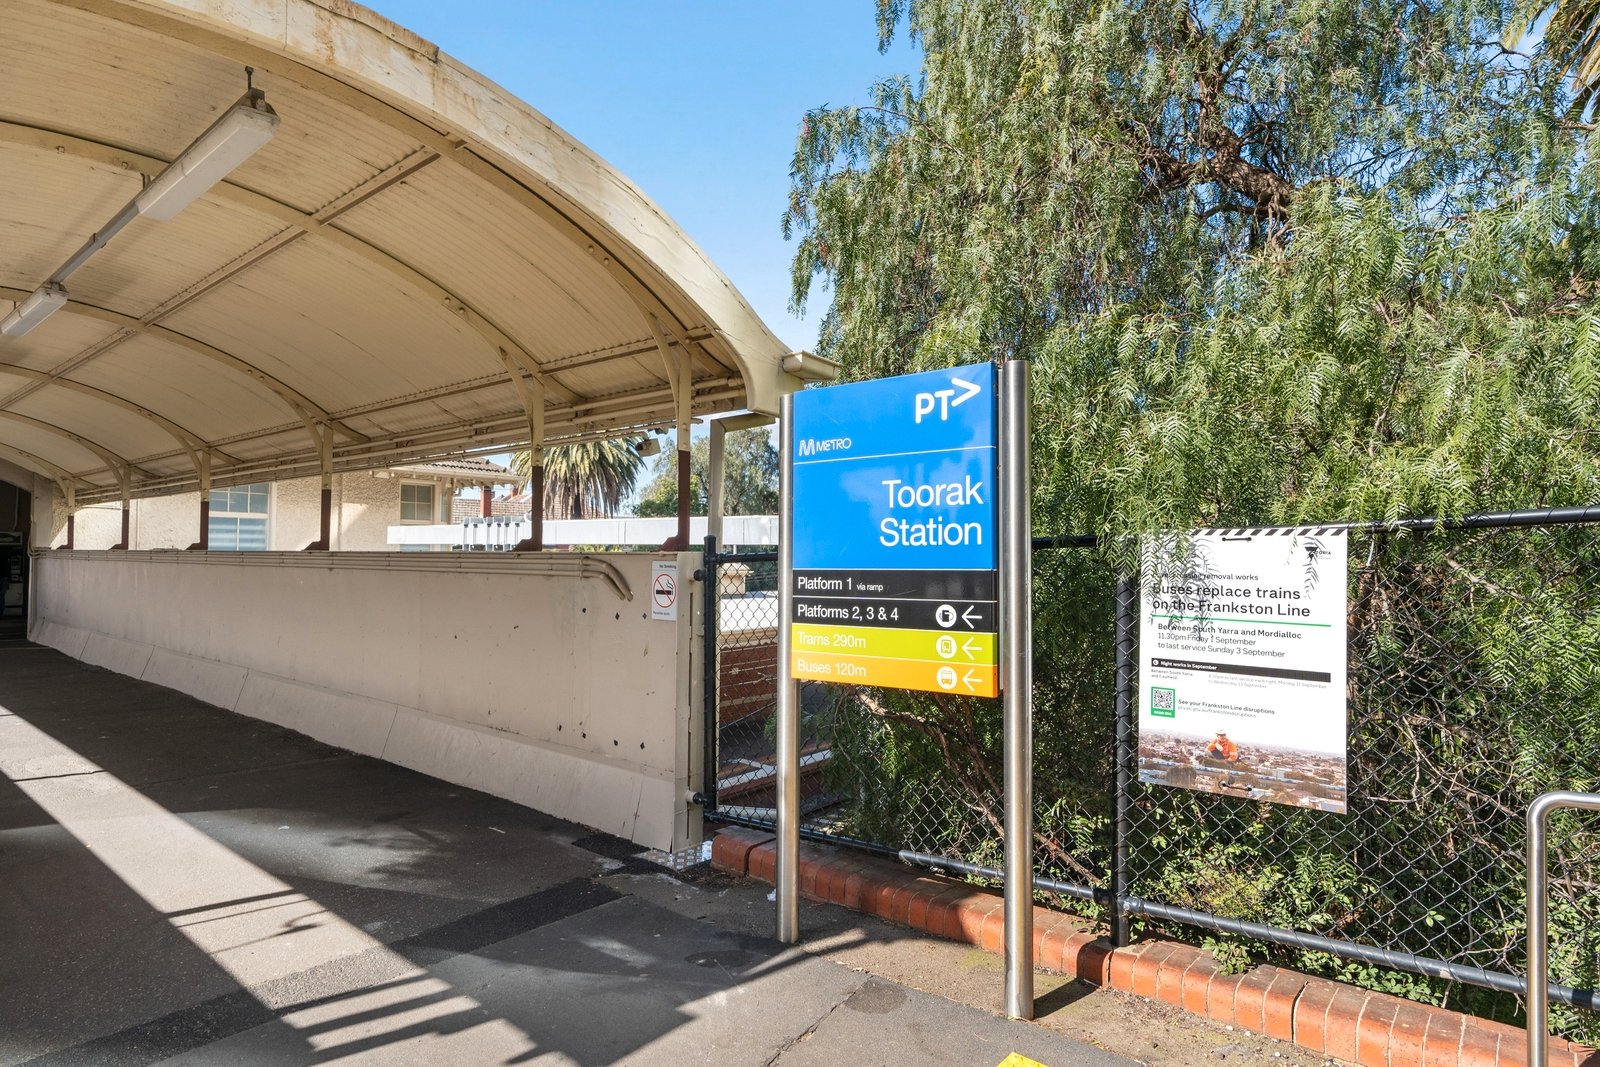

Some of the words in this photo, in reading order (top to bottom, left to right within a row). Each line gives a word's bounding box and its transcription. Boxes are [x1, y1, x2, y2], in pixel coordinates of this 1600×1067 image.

[816, 437, 852, 452] METRO
[881, 475, 984, 508] Toorak
[879, 516, 983, 547] Station
[797, 576, 843, 591] Platform
[846, 577, 852, 590] 1
[856, 582, 866, 591] via
[867, 584, 884, 593] ramp
[1235, 573, 1259, 581] works
[1196, 585, 1251, 599] replace
[1256, 587, 1301, 599] trains
[797, 603, 849, 619] Platforms
[851, 606, 863, 622] 2,
[866, 607, 875, 620] 3
[879, 607, 887, 621] &
[890, 607, 899, 621] 4
[1153, 600, 1169, 610] on
[1172, 599, 1195, 611] the
[1199, 600, 1273, 615] Frankston
[1277, 604, 1311, 617] Line
[1158, 623, 1191, 632] Between
[1192, 625, 1216, 633] South
[1217, 626, 1239, 635] Yarra
[1257, 629, 1302, 639] Mordialloc
[1158, 632, 1186, 641] 11.30pm
[1187, 634, 1209, 644] Friday
[1215, 636, 1257, 646] September
[797, 631, 830, 646] Trams
[833, 633, 866, 649] 290m
[1166, 642, 1179, 650] last
[1180, 644, 1206, 652] service
[1207, 645, 1235, 655] Sunday
[1236, 647, 1241, 655] 3
[1242, 647, 1286, 658] September
[797, 659, 831, 674] Buses
[835, 663, 867, 678] 120m
[1202, 701, 1230, 710] Frankston
[1243, 706, 1275, 715] disruptions
